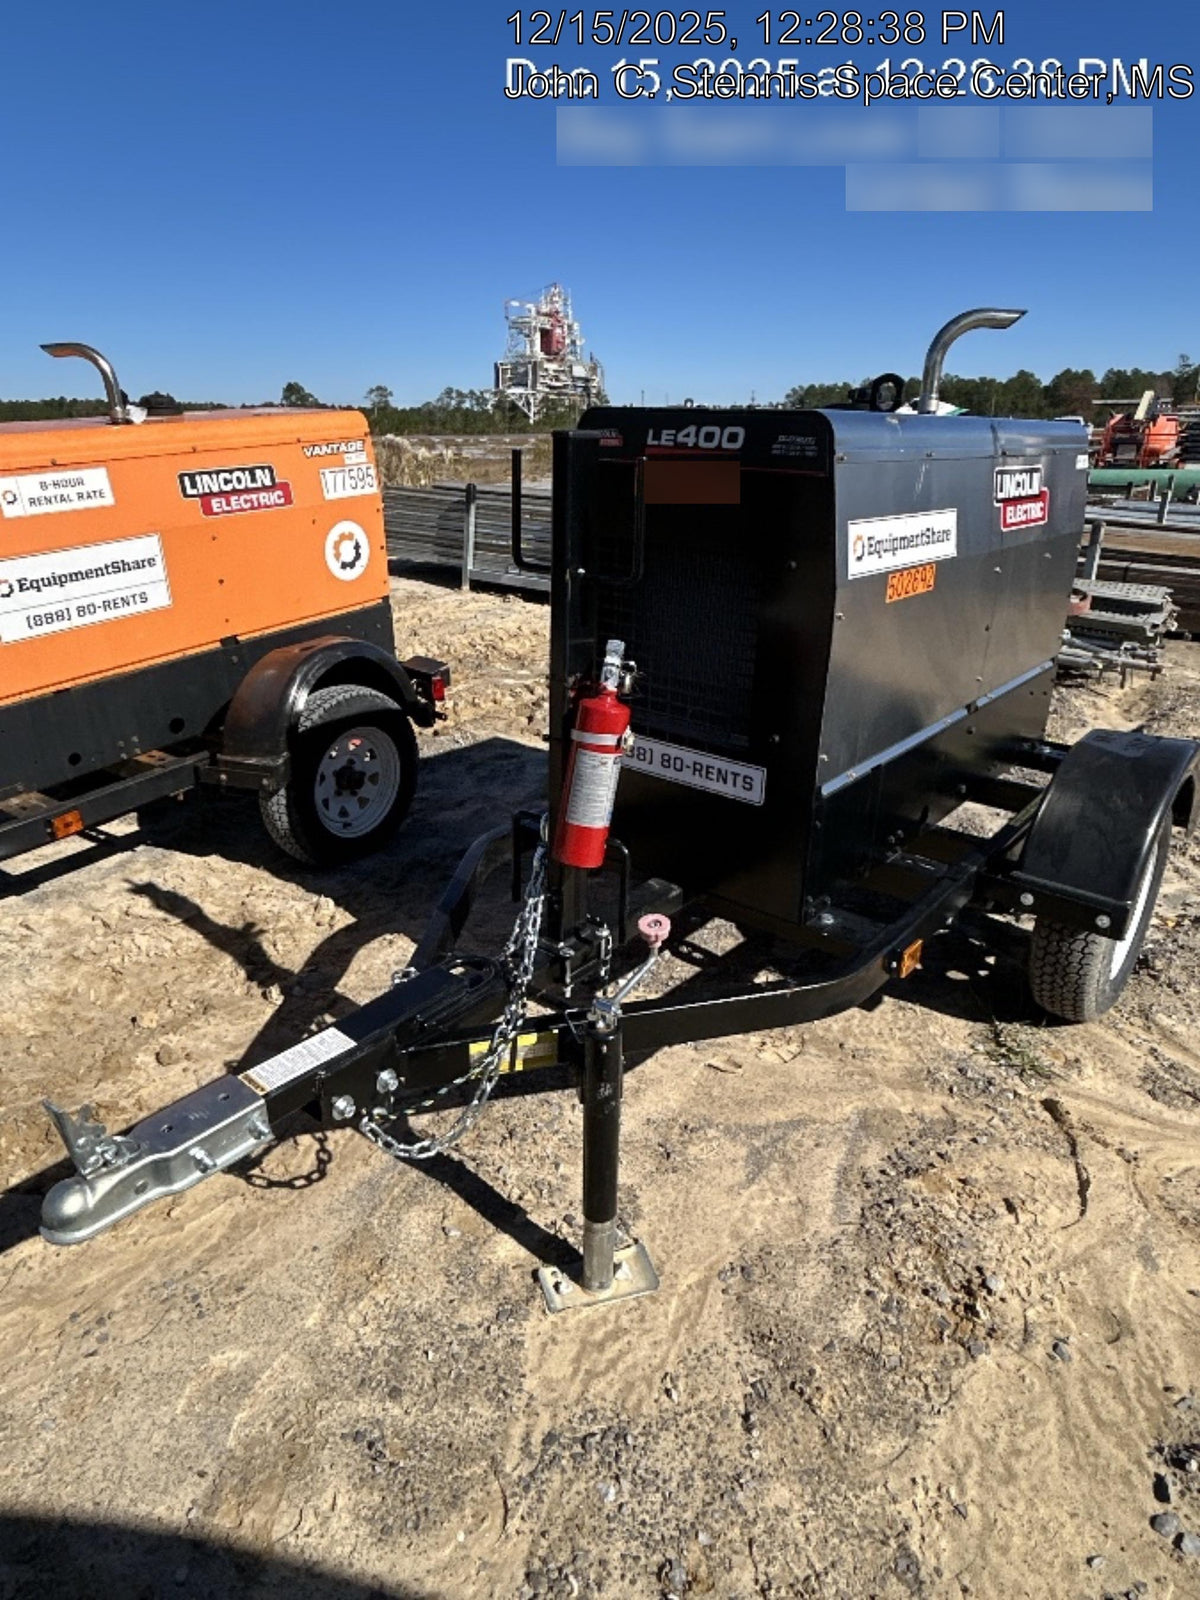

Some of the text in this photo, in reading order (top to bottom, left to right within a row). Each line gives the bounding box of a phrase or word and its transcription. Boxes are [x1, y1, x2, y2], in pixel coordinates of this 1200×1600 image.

[303, 440, 364, 459] VANTAGE
[646, 424, 745, 449] LE400
[183, 468, 272, 495] LINCOLN
[322, 466, 374, 494] 177595
[997, 472, 1041, 499] LINCOLN
[28, 489, 106, 507] RENTAL RATE
[211, 490, 285, 513] ELECTRIC
[867, 527, 951, 559] EquipmentShare
[16, 556, 157, 593] EquipmentShare
[76, 591, 148, 618] 80-RENTS
[660, 752, 754, 792] 80-RENTS
